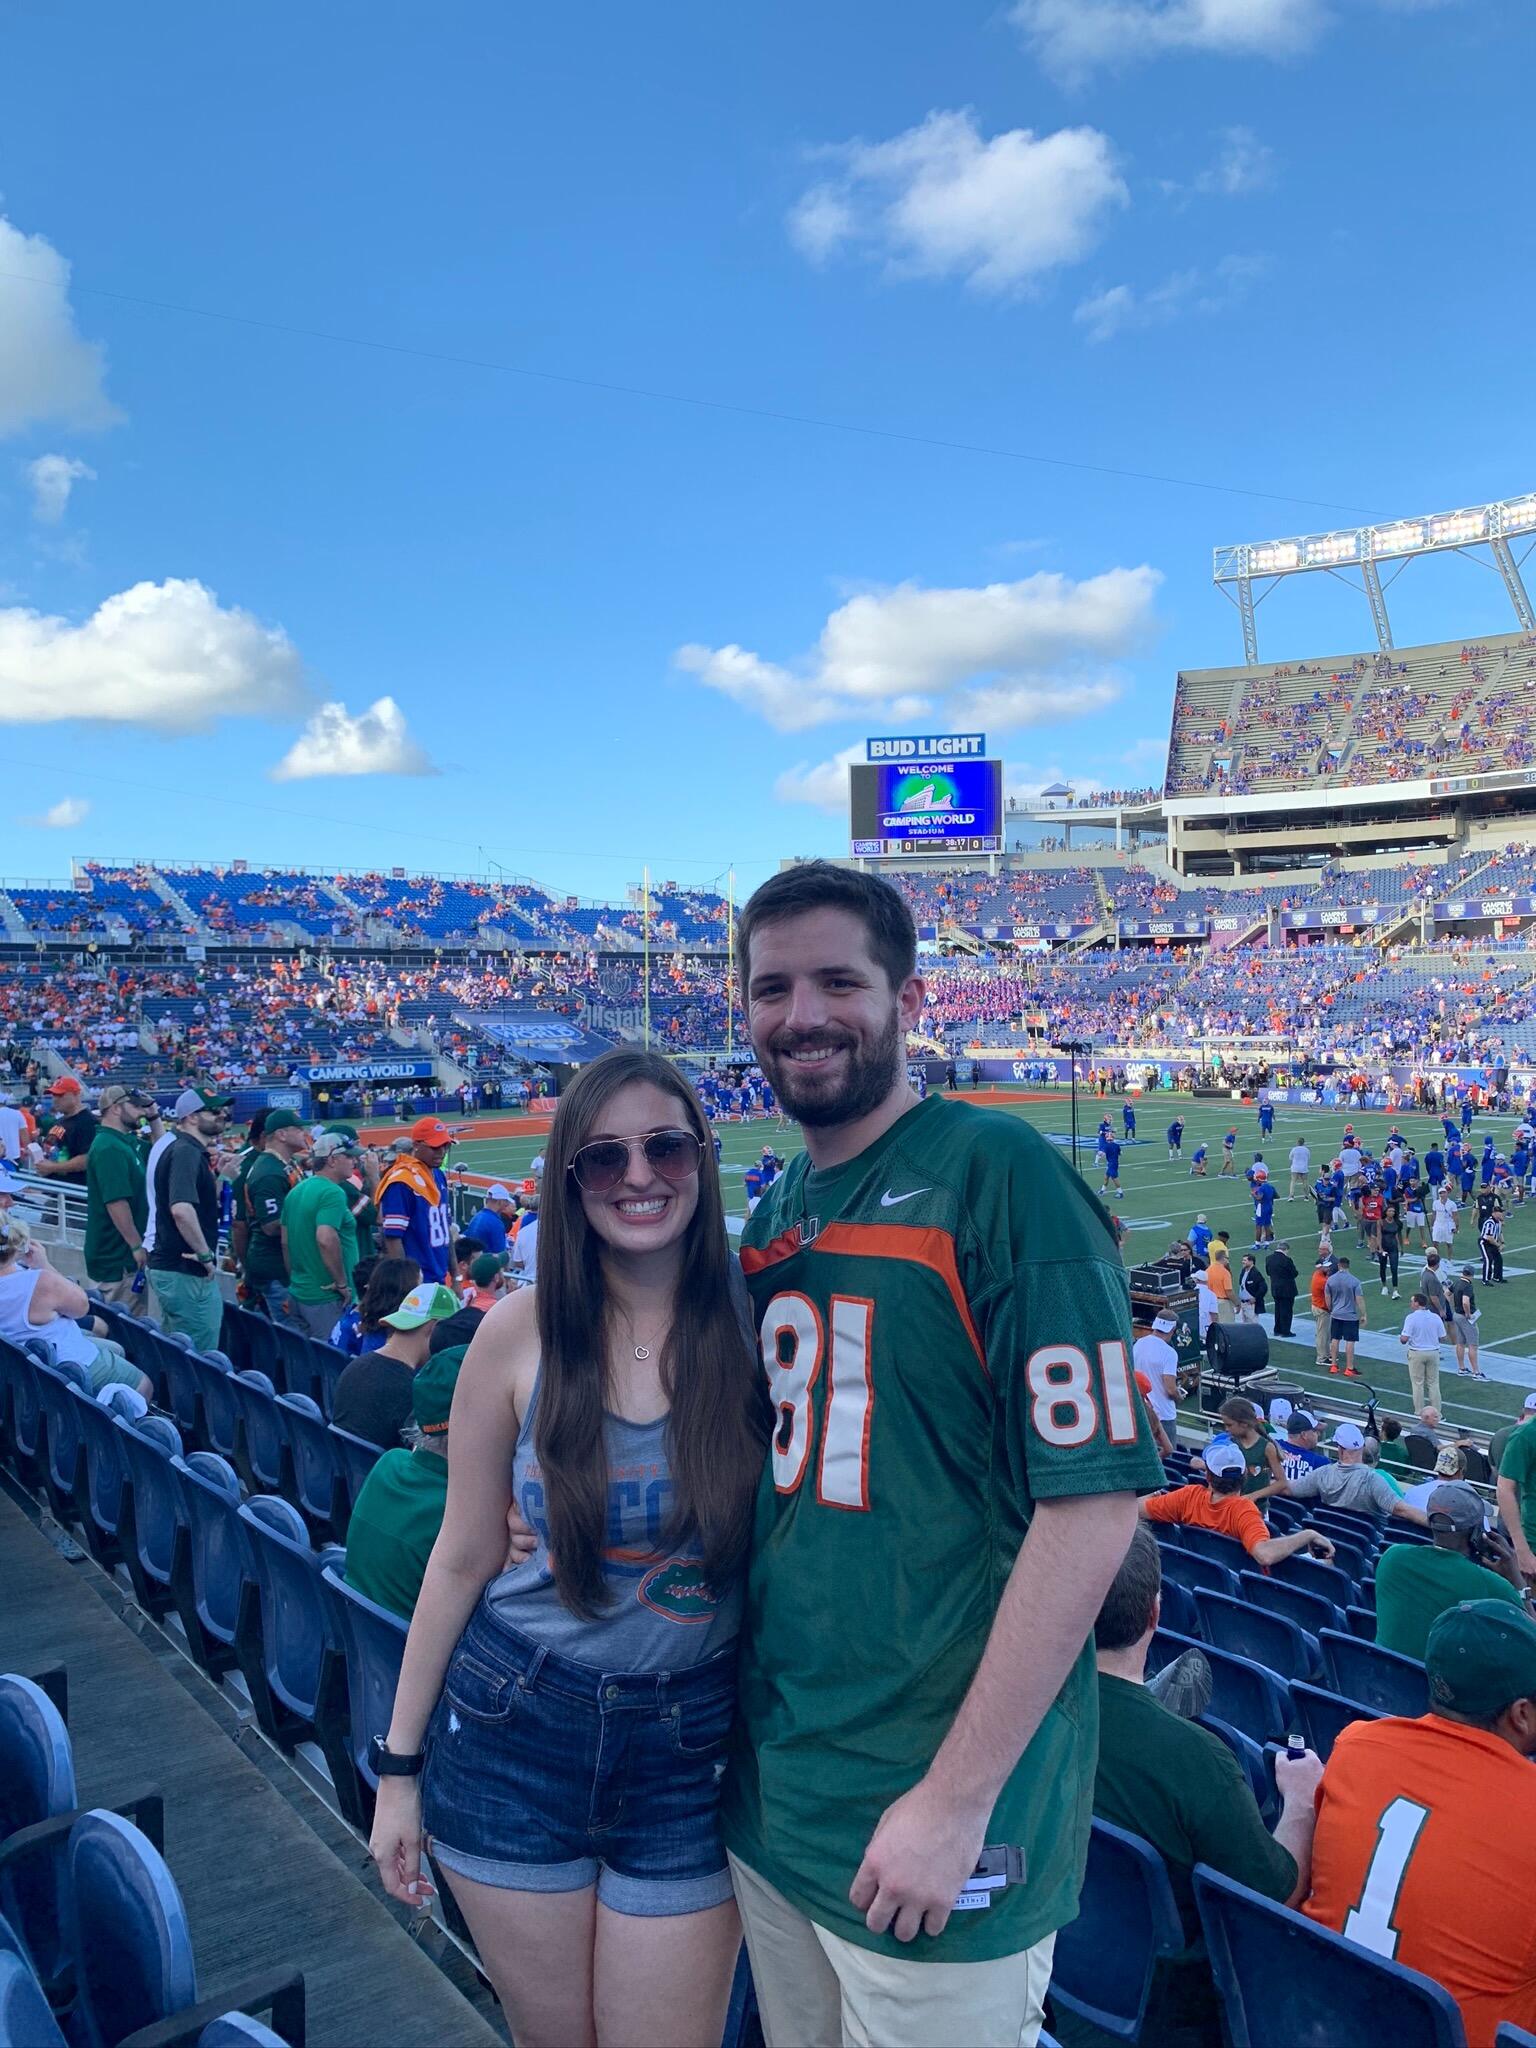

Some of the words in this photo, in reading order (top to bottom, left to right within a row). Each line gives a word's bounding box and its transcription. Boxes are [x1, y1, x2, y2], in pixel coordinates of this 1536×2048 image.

[870, 740, 916, 757] BUD
[918, 737, 981, 755] LIGHT
[897, 765, 954, 775] WELCOME
[1471, 779, 1479, 788] 0
[882, 816, 933, 827] CAMPING
[931, 814, 975, 825] WORLD
[904, 842, 911, 850] 0
[972, 840, 979, 849] 0
[1482, 907, 1513, 915] WORLD
[577, 1004, 650, 1028] Allstate
[308, 1066, 369, 1080] CAMPING
[370, 1065, 415, 1078] WORLD
[523, 1180, 535, 1190] 20
[265, 1198, 278, 1214] 5
[428, 1203, 450, 1248] 81
[794, 1215, 820, 1248] U
[1177, 1362, 1198, 1373] OOTBALL
[759, 1290, 875, 1512] 81
[1025, 1339, 1137, 1448] 81
[1342, 1795, 1432, 1959] 1
